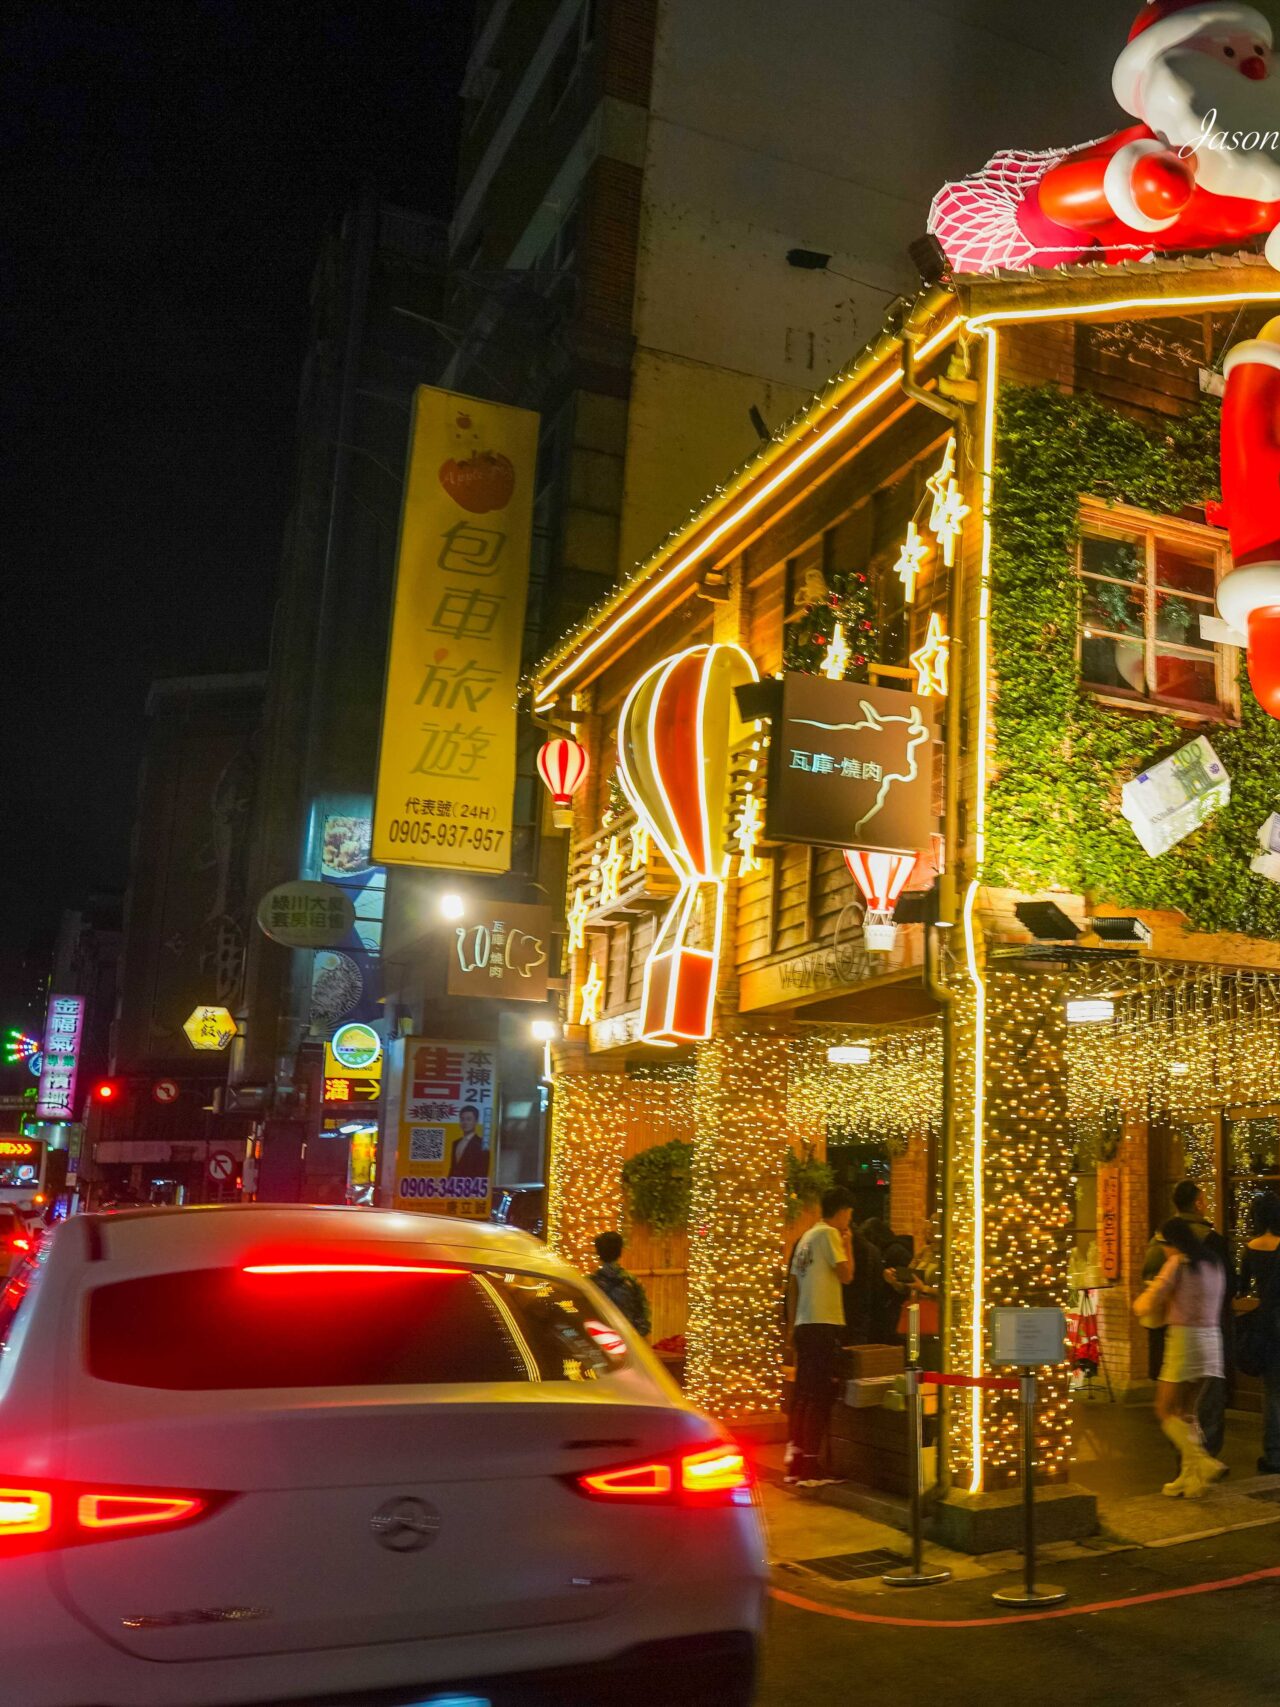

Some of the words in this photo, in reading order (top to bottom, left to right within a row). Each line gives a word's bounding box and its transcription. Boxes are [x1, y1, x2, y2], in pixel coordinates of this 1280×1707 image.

[409, 519, 507, 782] 包車旅遊
[388, 819, 505, 854] 0905-937-957
[413, 1046, 465, 1101] 售
[400, 1177, 488, 1199] 0906-345845
